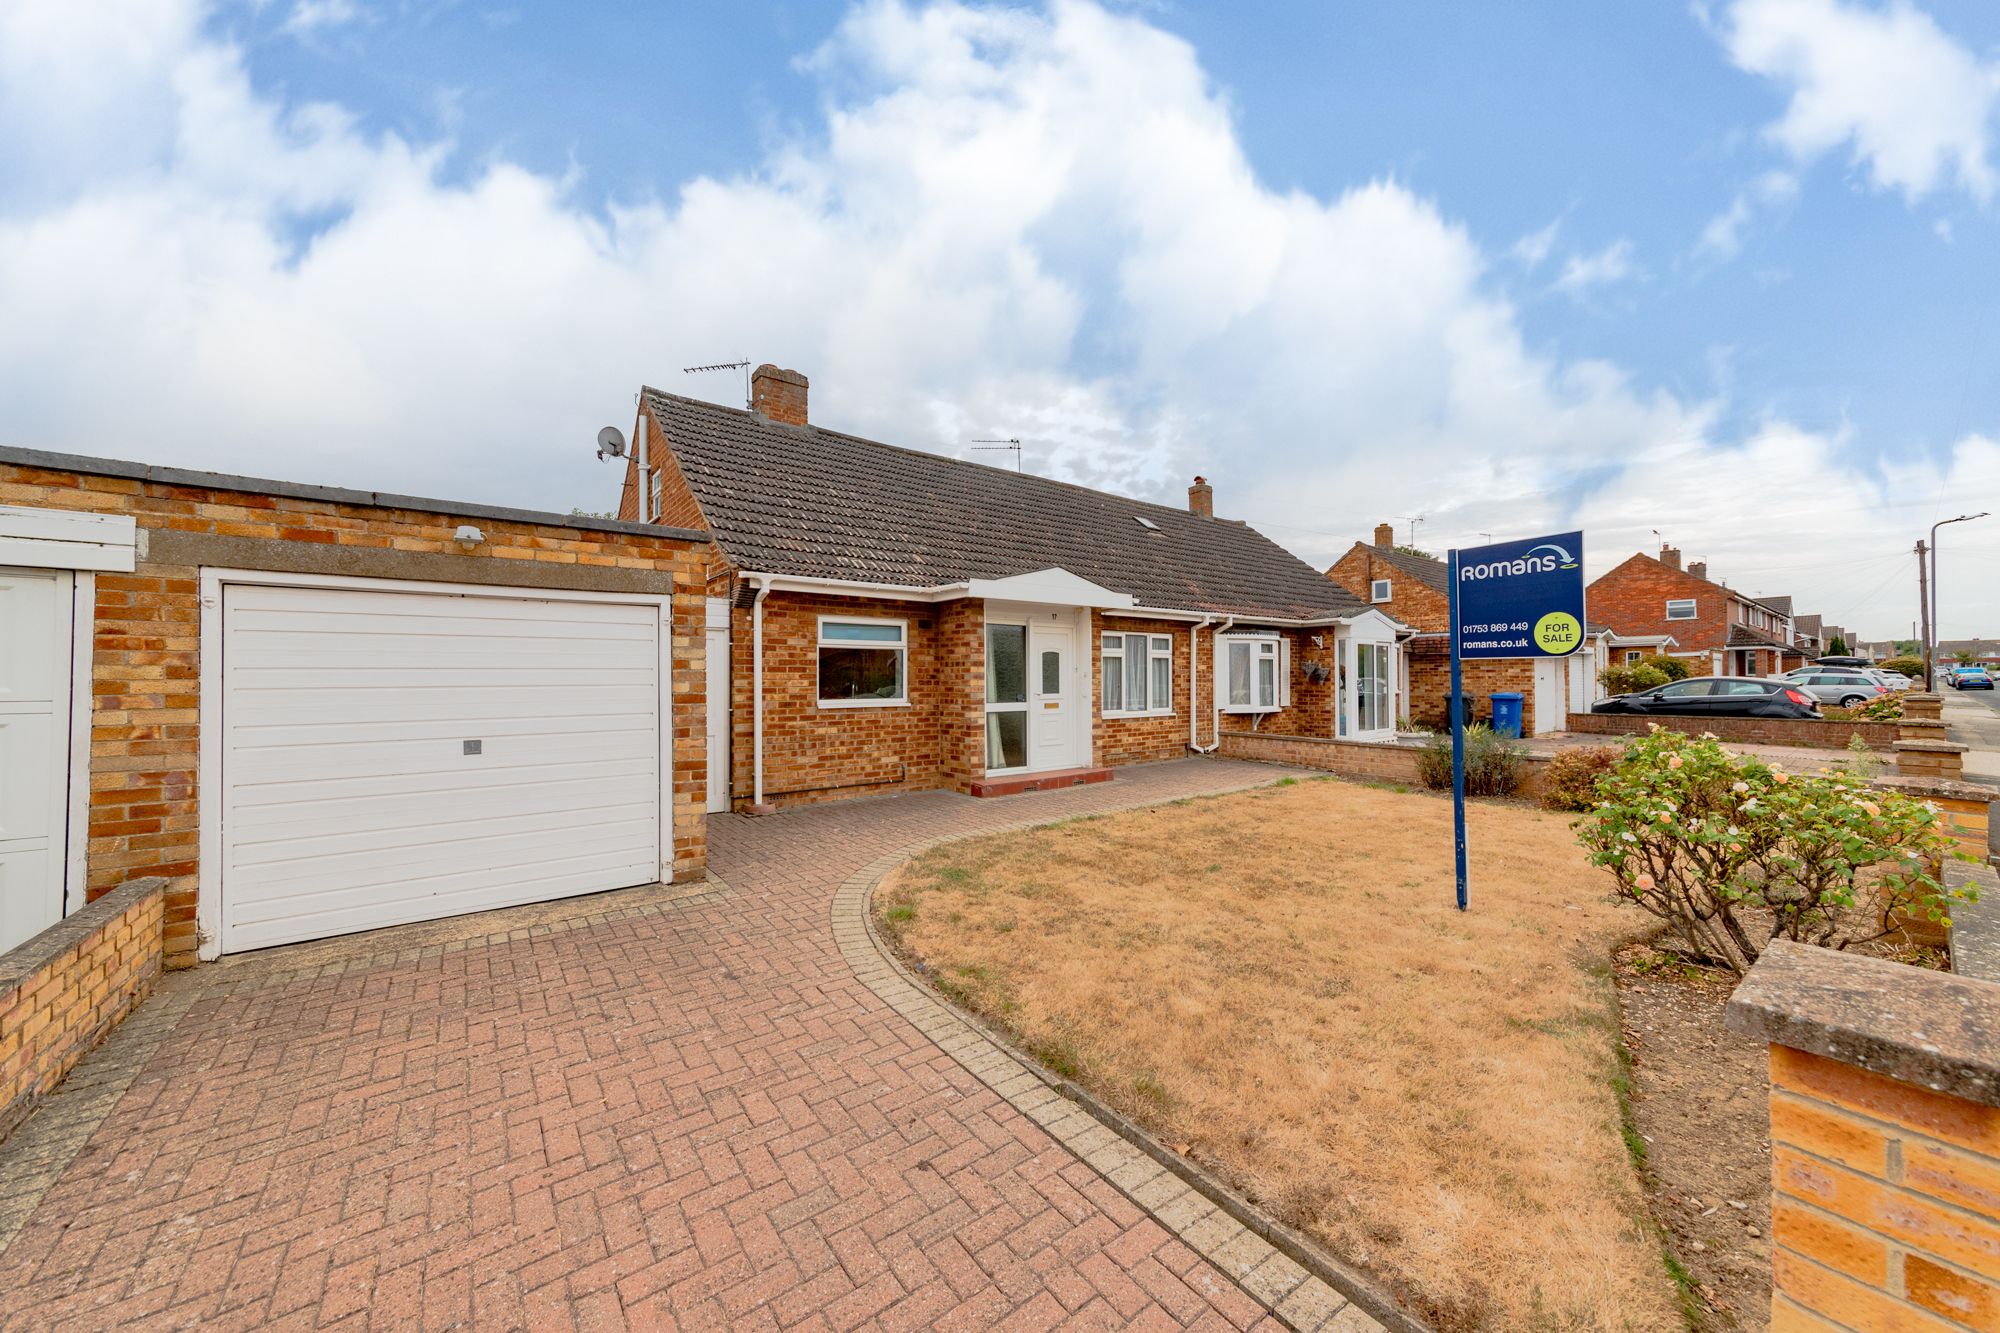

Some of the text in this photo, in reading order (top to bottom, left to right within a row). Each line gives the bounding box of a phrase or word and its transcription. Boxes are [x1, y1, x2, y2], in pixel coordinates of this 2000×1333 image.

[1463, 621, 1528, 634] 01753 869 449
[1545, 623, 1570, 632] FOR
[1463, 638, 1528, 649] romans.co.uk
[1543, 634, 1573, 643] SALE
